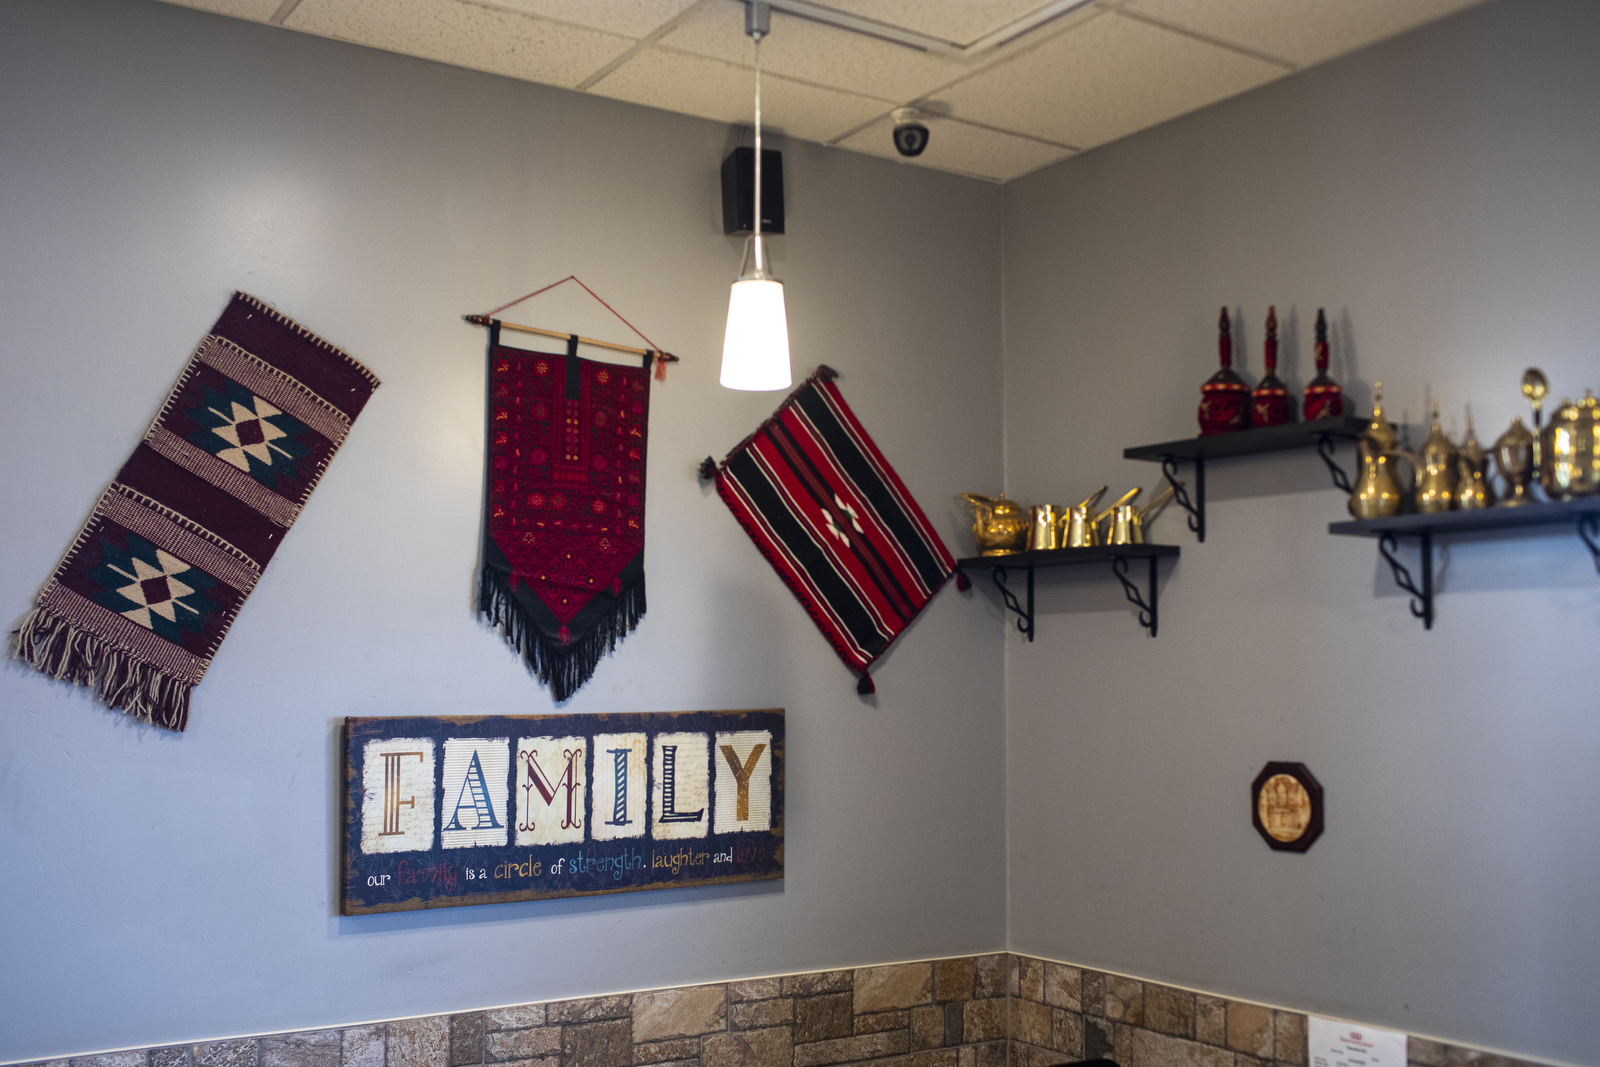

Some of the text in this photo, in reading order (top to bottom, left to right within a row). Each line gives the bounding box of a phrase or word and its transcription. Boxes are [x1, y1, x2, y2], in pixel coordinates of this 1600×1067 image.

[378, 744, 767, 837] FAMILY
[367, 874, 391, 887] our
[397, 858, 457, 892] family
[465, 867, 476, 881] is
[478, 868, 488, 880] a
[494, 854, 542, 880] circle
[550, 857, 566, 875] of
[651, 847, 711, 875] laughter
[713, 846, 733, 863] and
